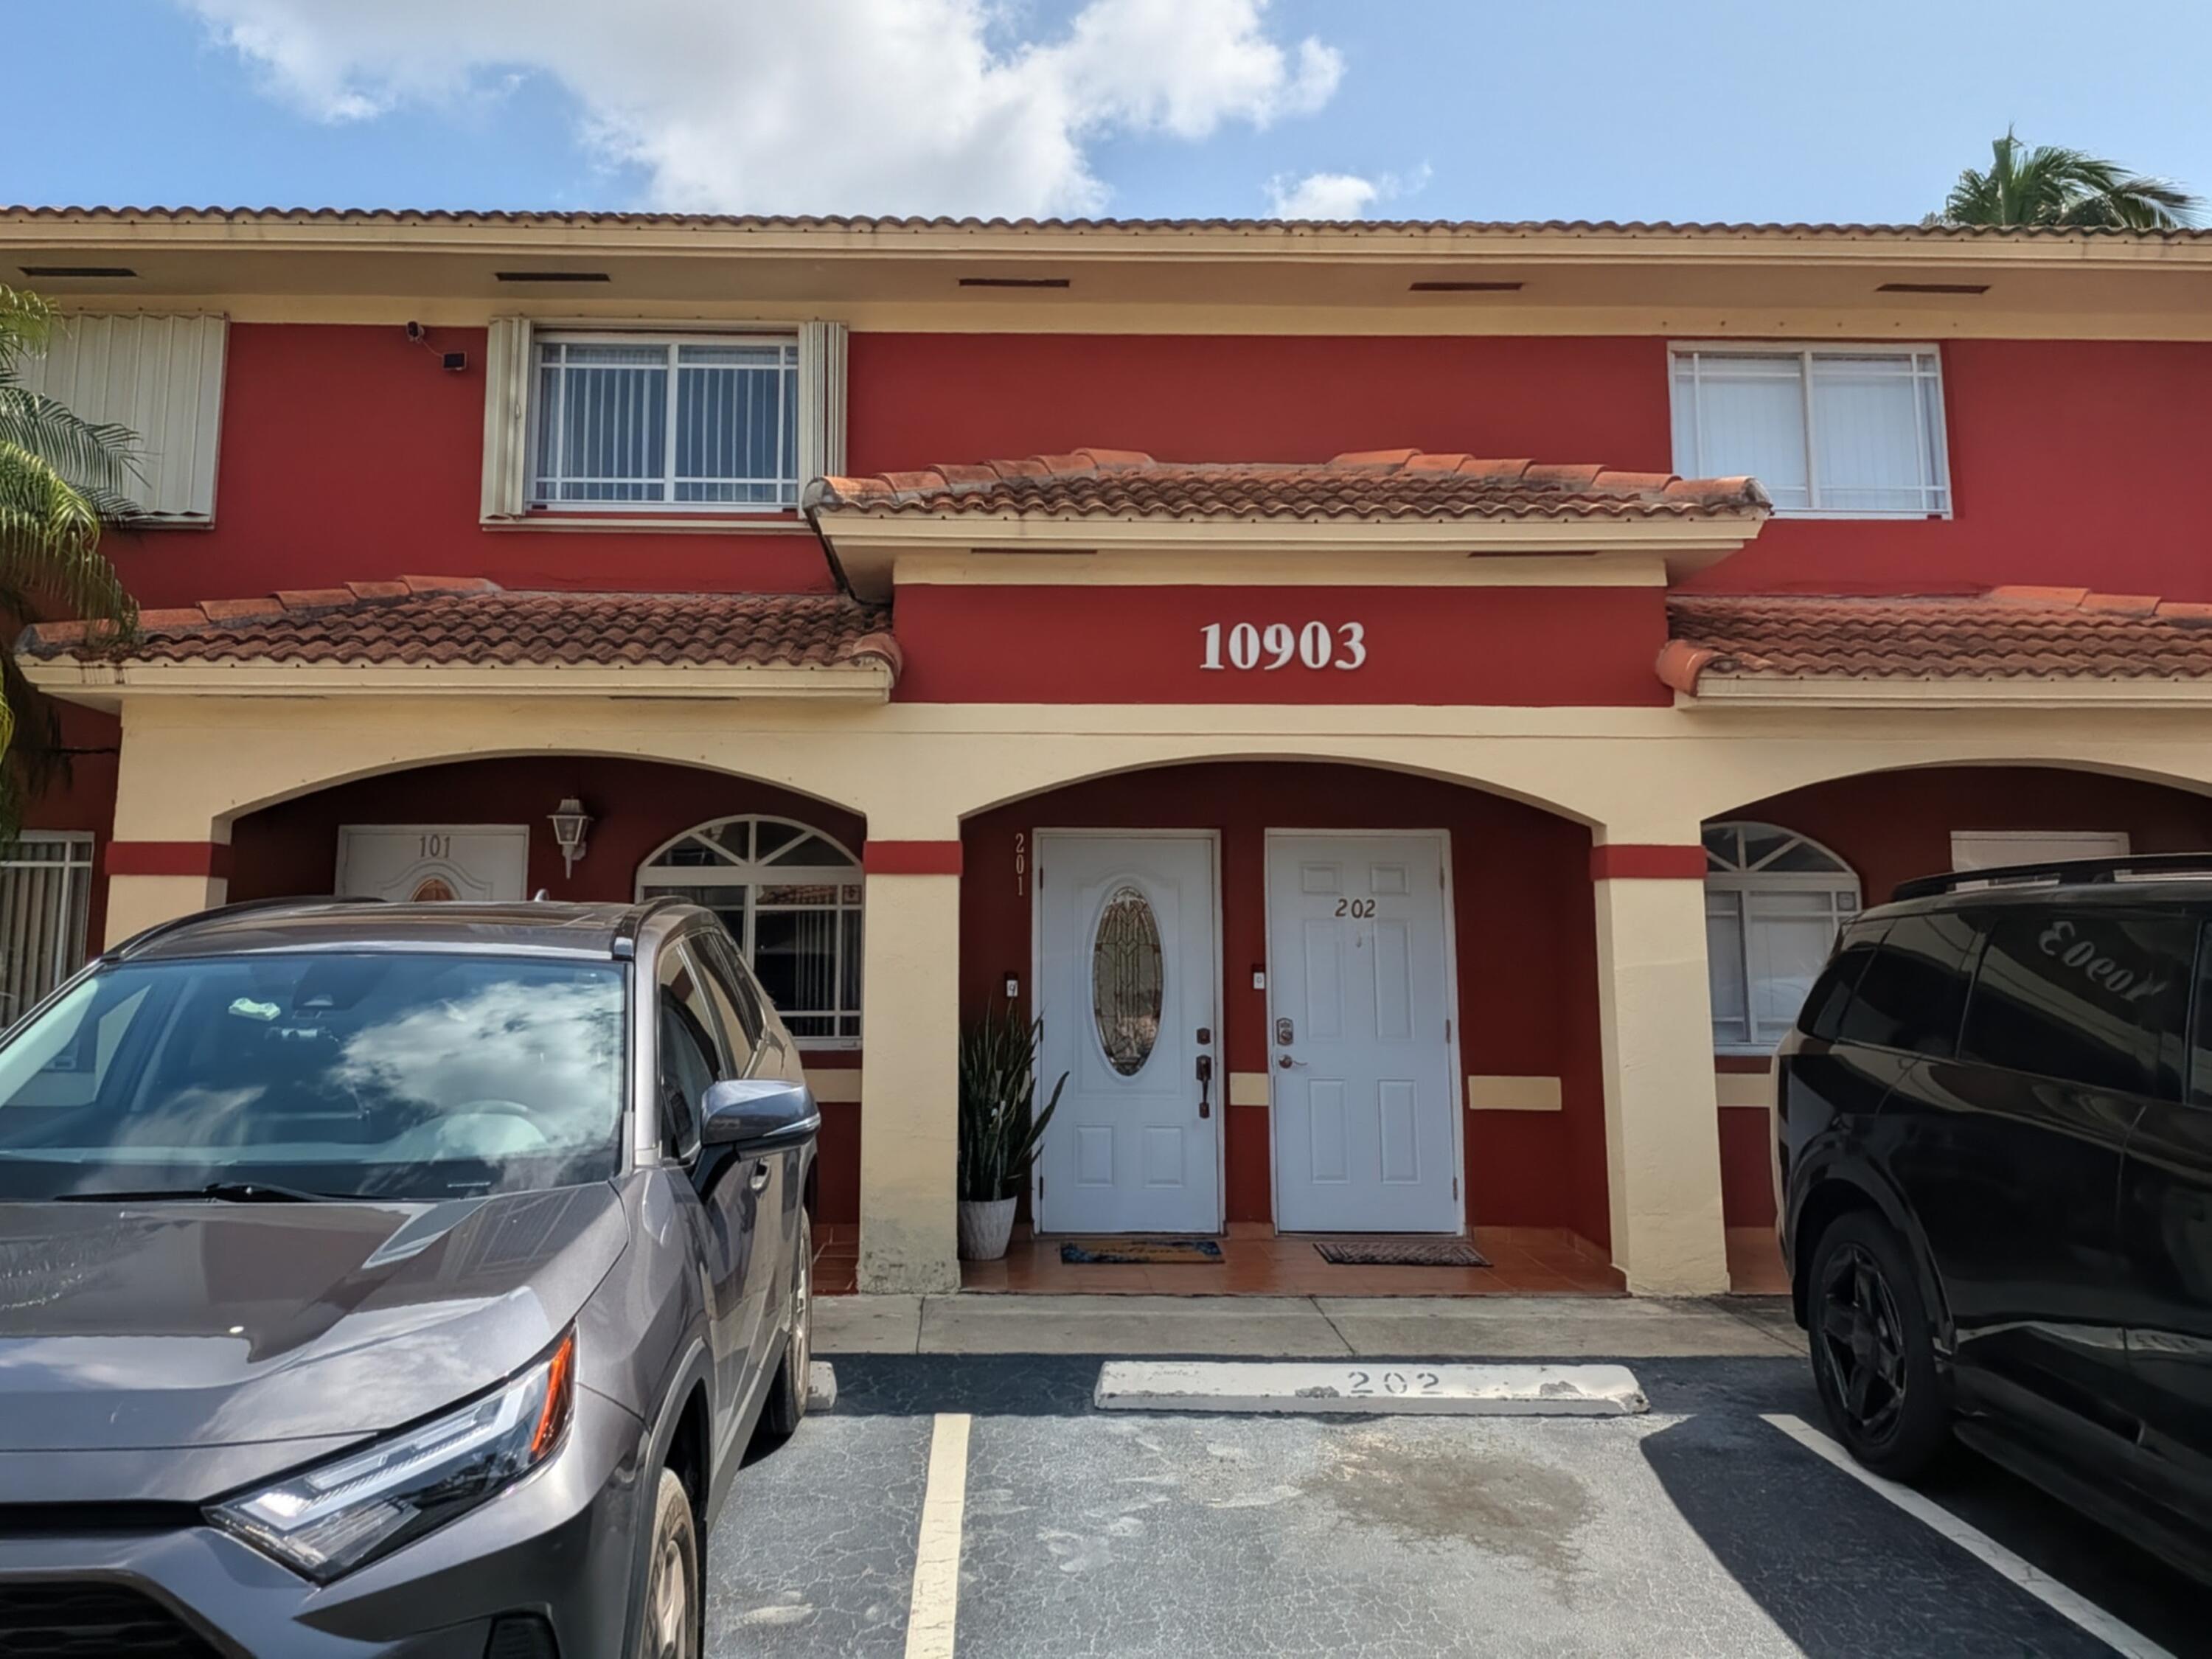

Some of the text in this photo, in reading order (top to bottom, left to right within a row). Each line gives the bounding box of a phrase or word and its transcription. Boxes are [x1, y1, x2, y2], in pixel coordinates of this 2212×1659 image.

[1200, 621, 1366, 670] 10903
[420, 834, 450, 858] 101
[1015, 832, 1024, 896] 201
[1335, 898, 1376, 919] 202
[1348, 1371, 1444, 1394] 202
